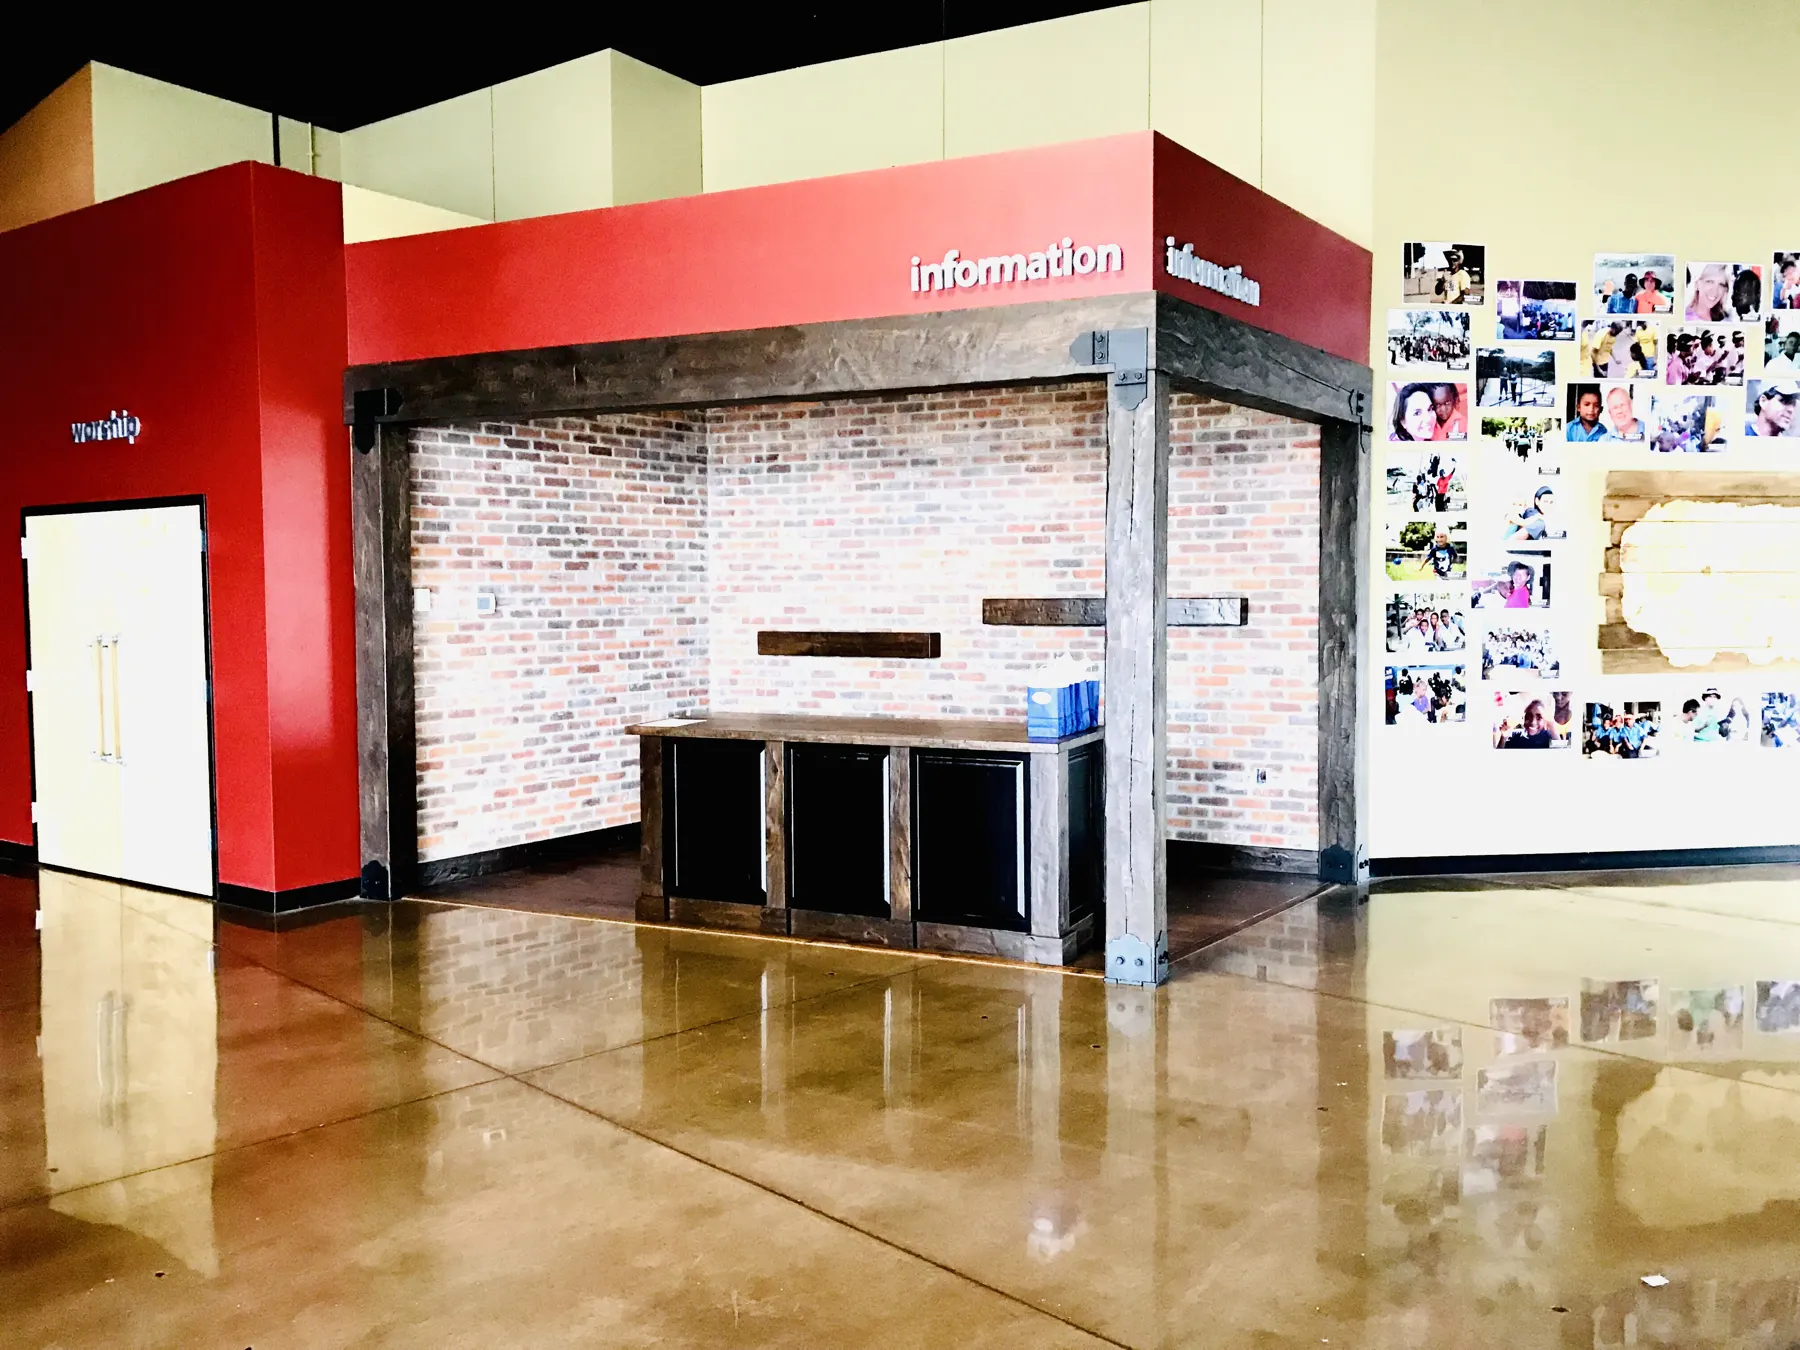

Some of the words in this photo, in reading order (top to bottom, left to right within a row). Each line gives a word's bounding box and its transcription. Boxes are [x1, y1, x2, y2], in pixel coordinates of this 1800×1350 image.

[911, 237, 1122, 292] information
[1166, 236, 1260, 306] information
[71, 410, 141, 444] worship
